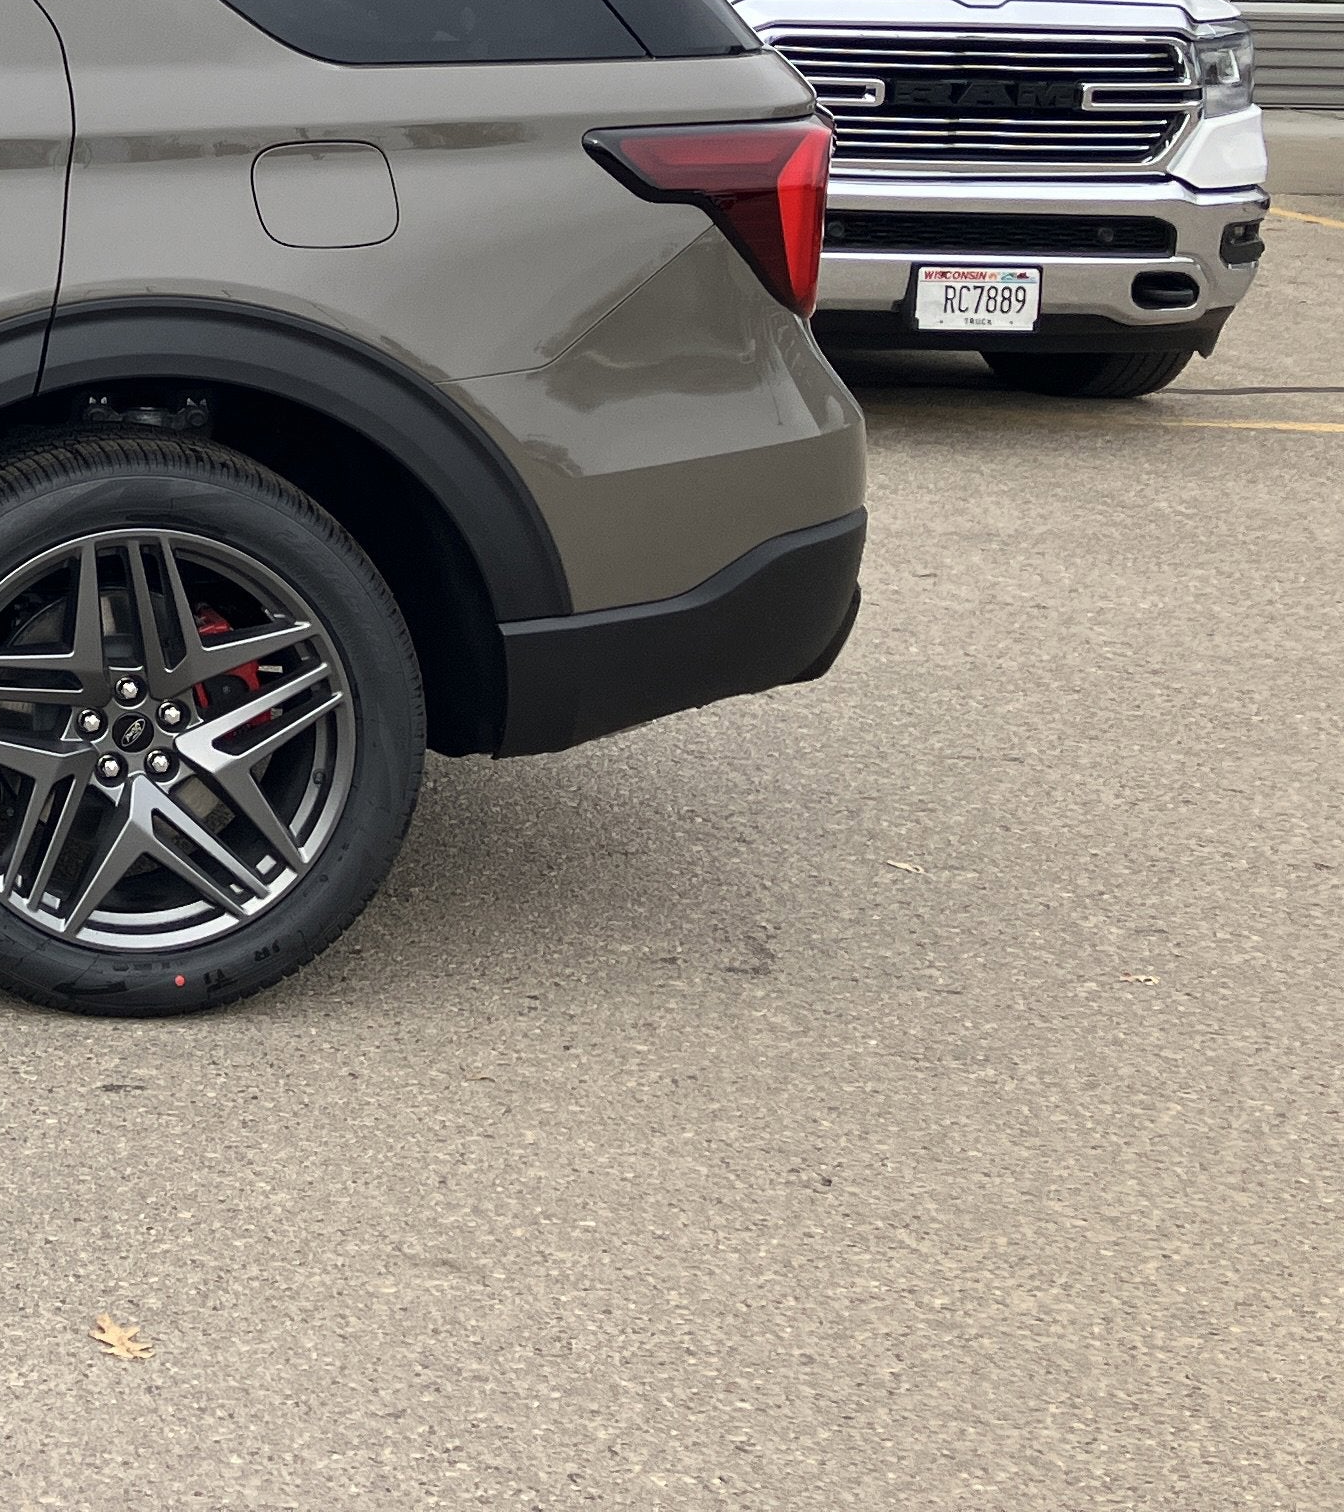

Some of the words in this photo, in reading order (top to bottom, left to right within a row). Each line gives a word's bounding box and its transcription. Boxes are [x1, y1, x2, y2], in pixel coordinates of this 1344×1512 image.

[895, 79, 1075, 108] RAM
[924, 270, 988, 281] WISCONSIN
[943, 284, 1027, 314] RC7889
[964, 317, 993, 326] TRUCK
